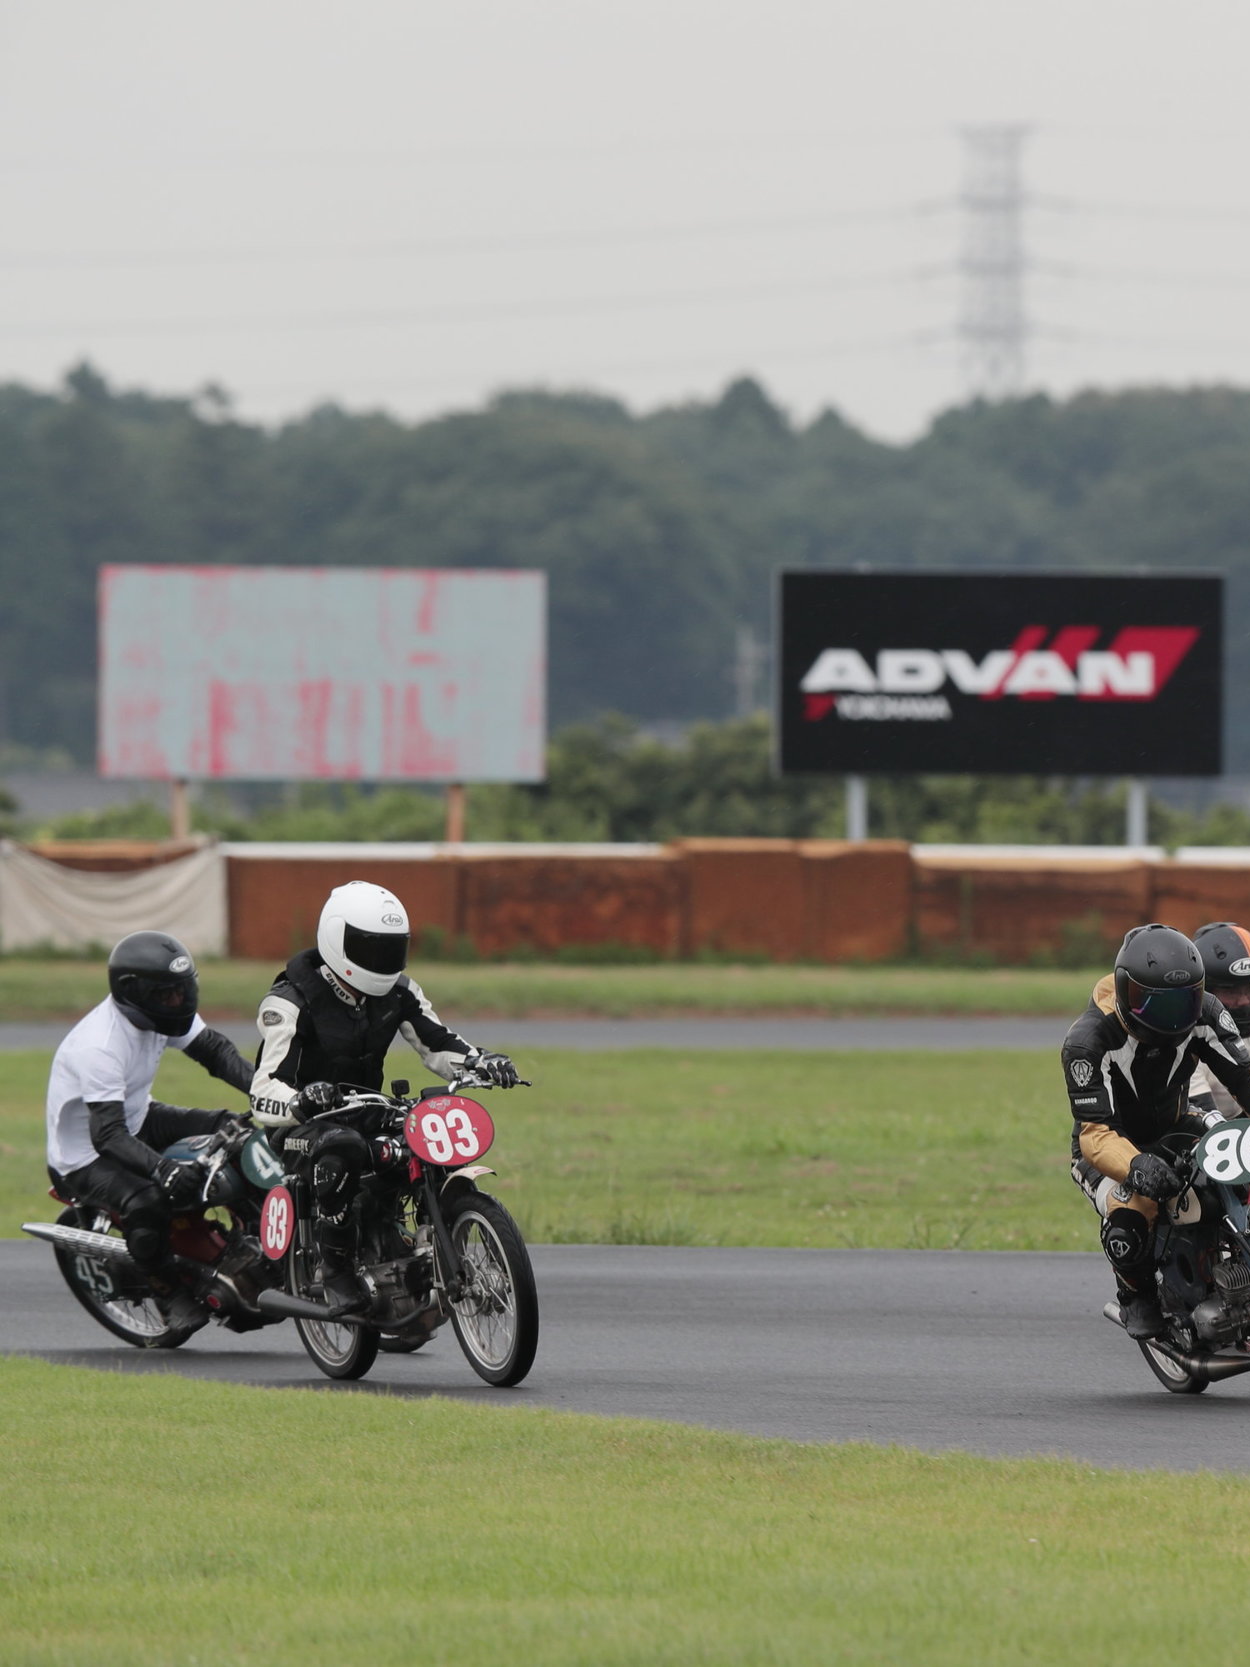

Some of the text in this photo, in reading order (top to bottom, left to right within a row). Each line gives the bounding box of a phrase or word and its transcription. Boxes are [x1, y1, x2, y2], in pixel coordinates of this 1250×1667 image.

[801, 648, 1155, 694] ADVAN
[835, 696, 952, 720] YOKOHAMA
[421, 1108, 479, 1163] 93
[267, 1196, 288, 1250] 93
[75, 1255, 114, 1295] 45
